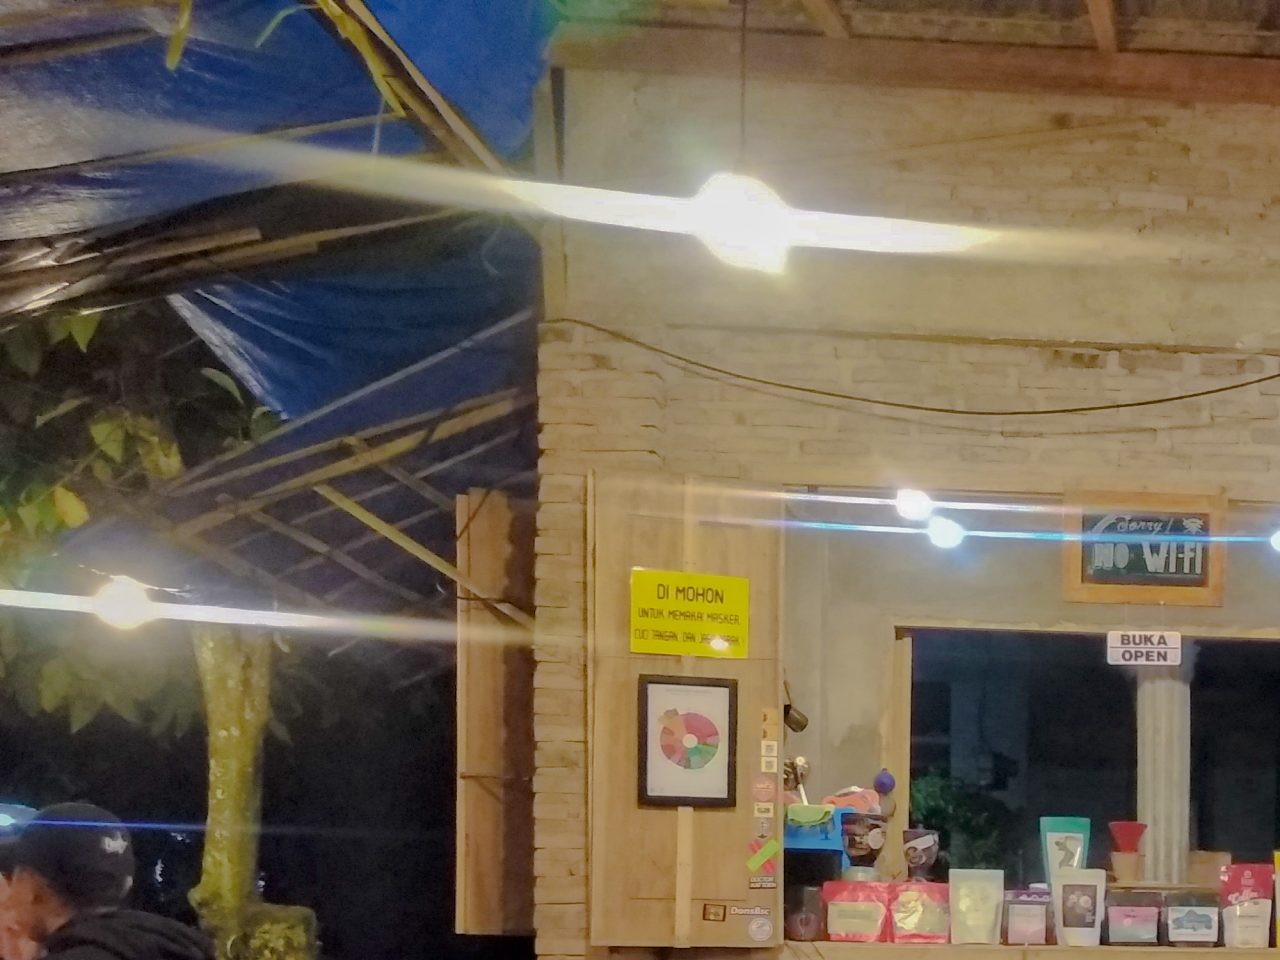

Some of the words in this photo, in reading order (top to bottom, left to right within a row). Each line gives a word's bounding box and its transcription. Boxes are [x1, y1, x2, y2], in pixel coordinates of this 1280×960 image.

[1093, 537, 1130, 570] NO
[657, 583, 669, 600] DI
[676, 586, 725, 605] MOHON
[638, 607, 664, 619] UNTUK
[1120, 634, 1168, 646] BUKA
[1121, 650, 1168, 662] OPEN
